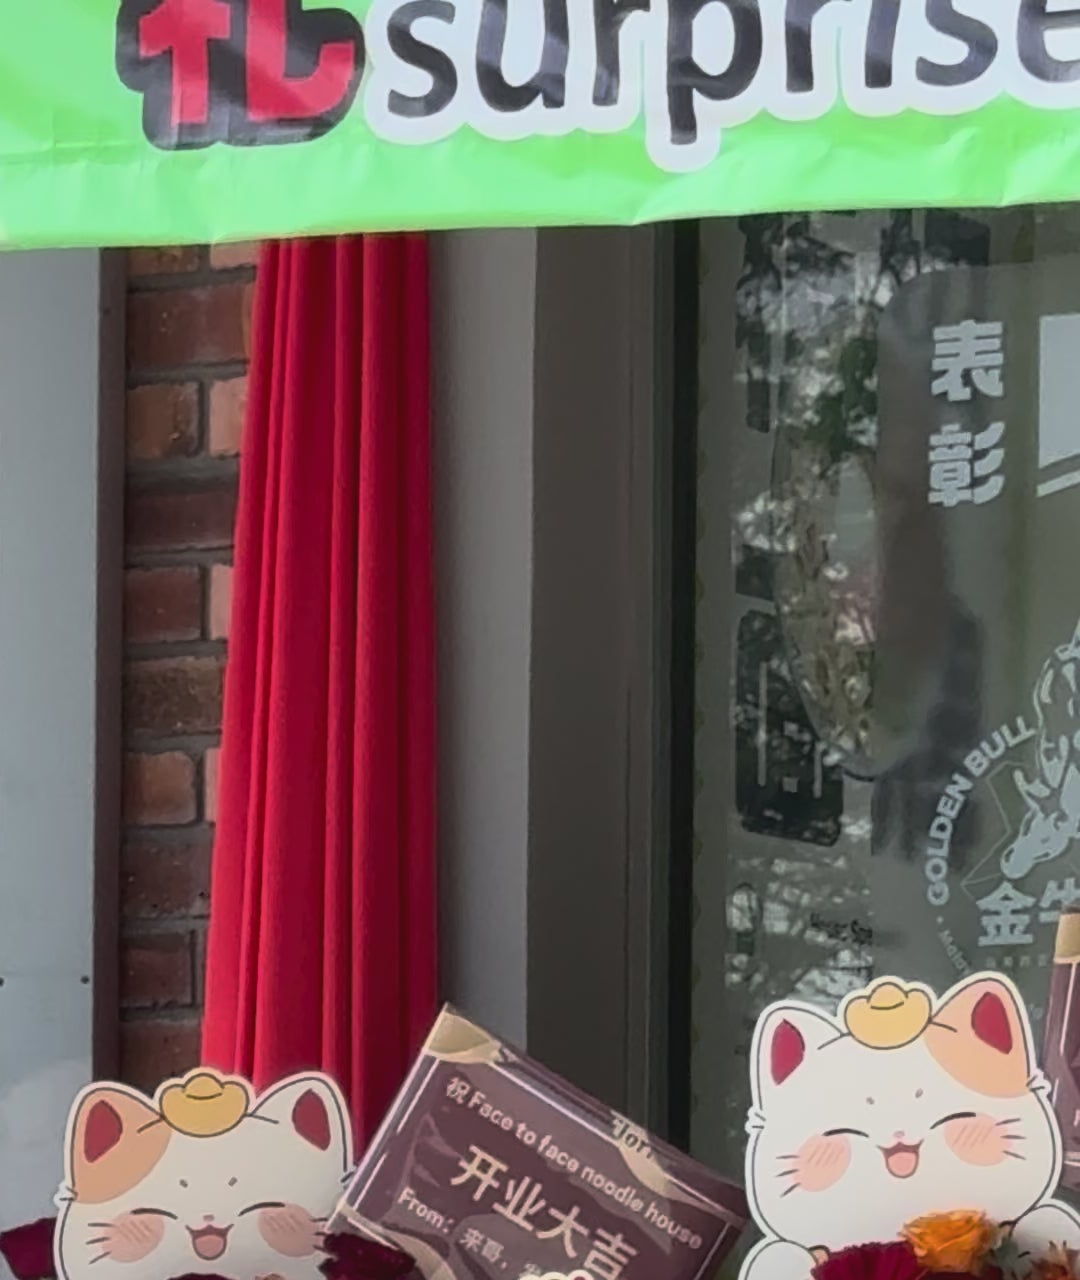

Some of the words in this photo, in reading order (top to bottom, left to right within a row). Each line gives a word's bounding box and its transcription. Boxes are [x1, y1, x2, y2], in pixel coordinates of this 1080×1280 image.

[386, 0, 1080, 144] surprise
[928, 319, 1005, 507] 表彰
[925, 772, 974, 906] GOLDEN
[963, 716, 1038, 777] BULL
[467, 1090, 514, 1131] Face
[515, 1121, 537, 1145] to
[537, 1133, 580, 1174] face
[580, 1164, 644, 1214] noodle
[643, 1200, 704, 1250] house
